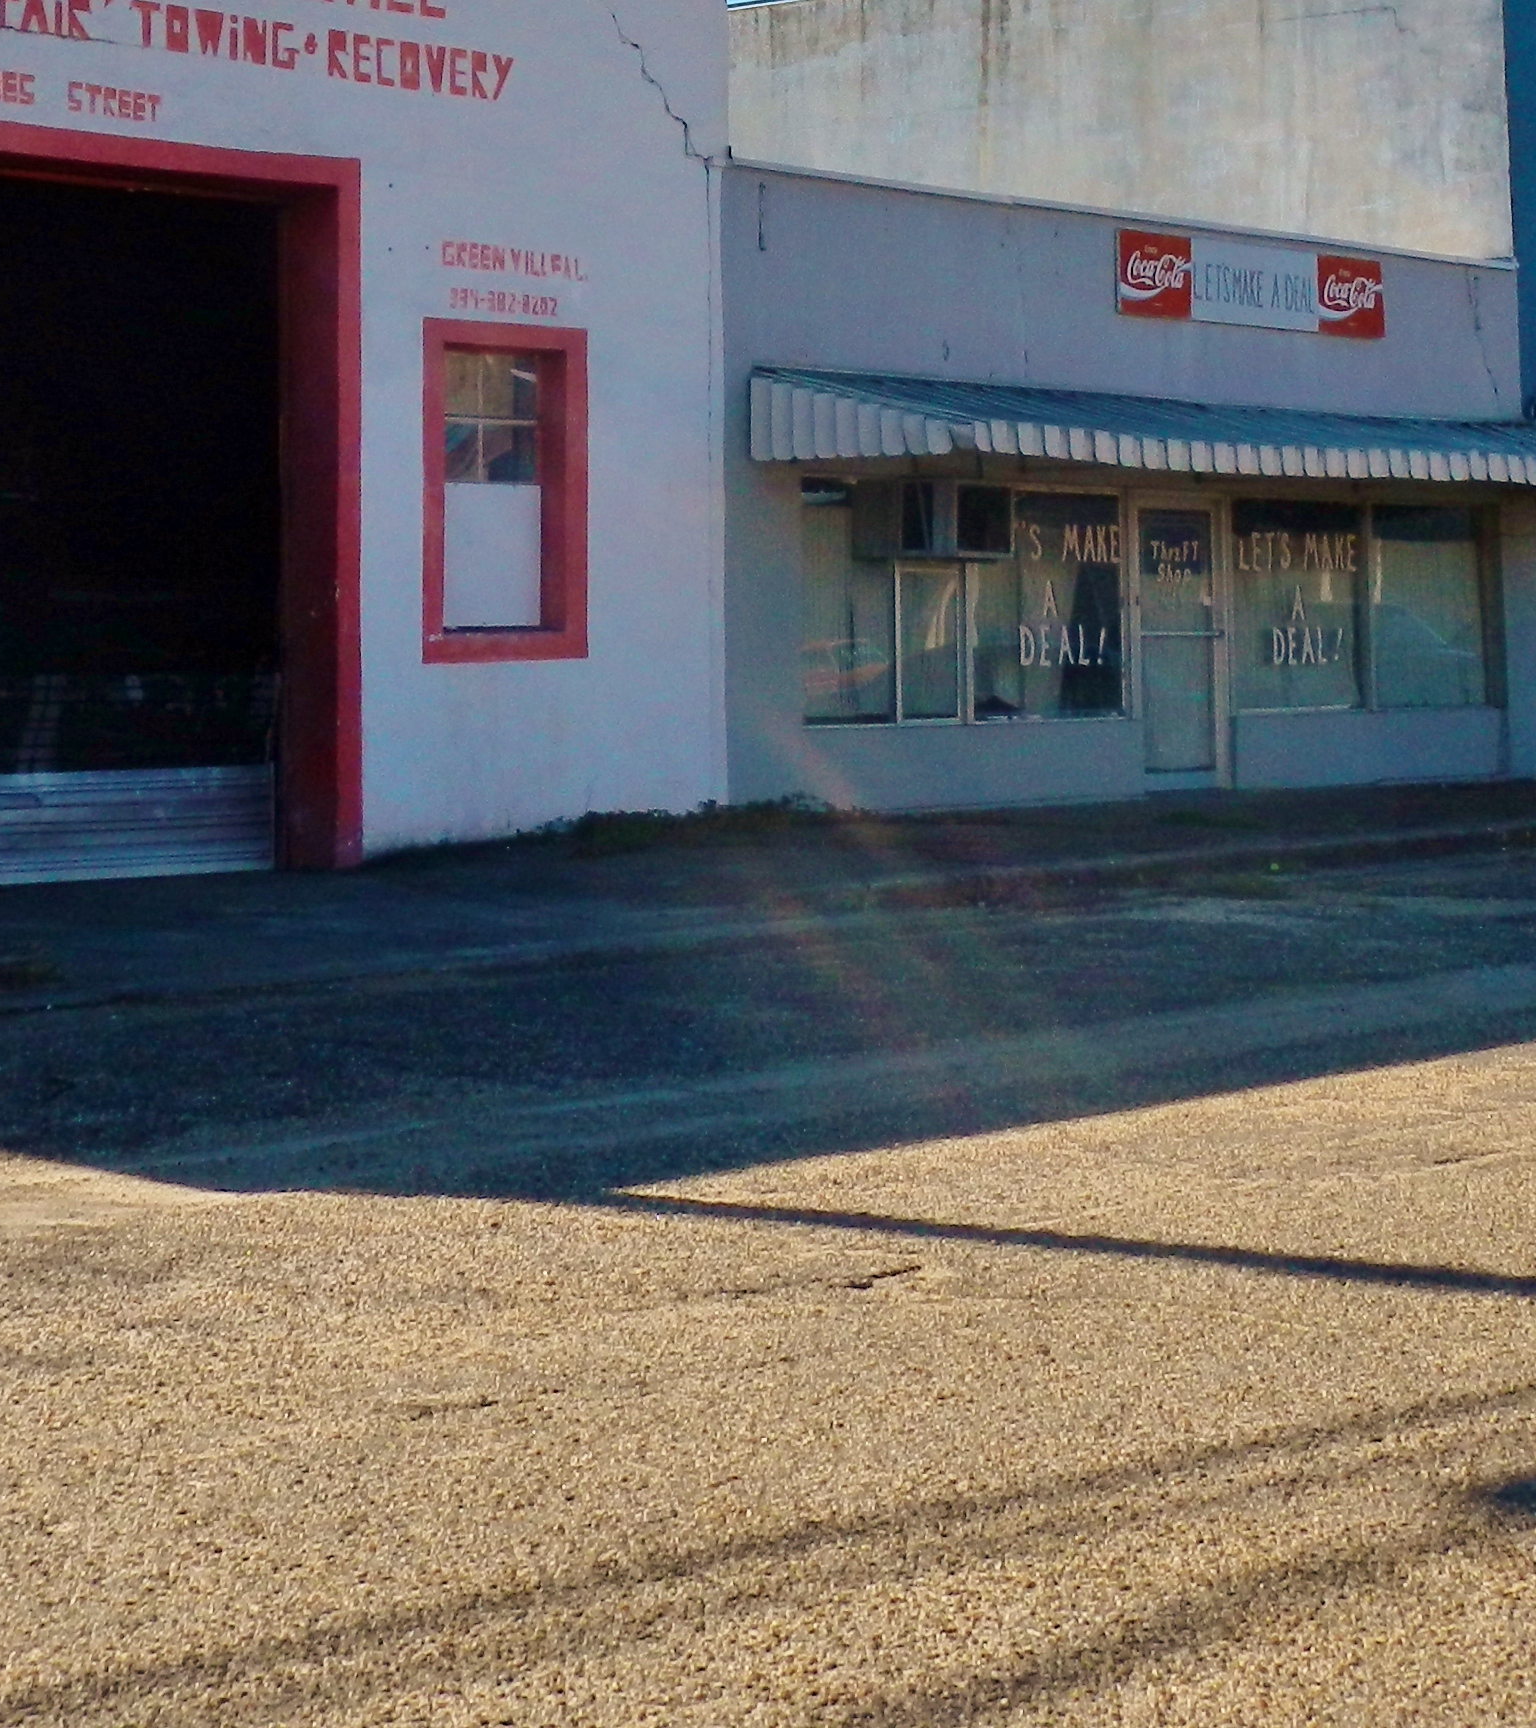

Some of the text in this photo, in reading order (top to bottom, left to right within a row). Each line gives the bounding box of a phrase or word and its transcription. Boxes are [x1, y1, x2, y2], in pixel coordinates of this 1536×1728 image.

[326, 28, 515, 101] RECOVERY
[67, 80, 161, 122] STREET
[1126, 250, 1185, 289] Coca-Cola
[1232, 266, 1264, 308] MAKE
[1270, 273, 1280, 308] A
[1284, 272, 1315, 314] DEAL
[1324, 274, 1376, 309] Coca-Cola
[1061, 523, 1121, 564] MAKE
[1303, 531, 1358, 572] MAKE
[1043, 580, 1058, 618] A
[1291, 584, 1306, 621] A
[1018, 624, 1107, 668] DEAL!
[1272, 626, 1344, 666] DEAL!
